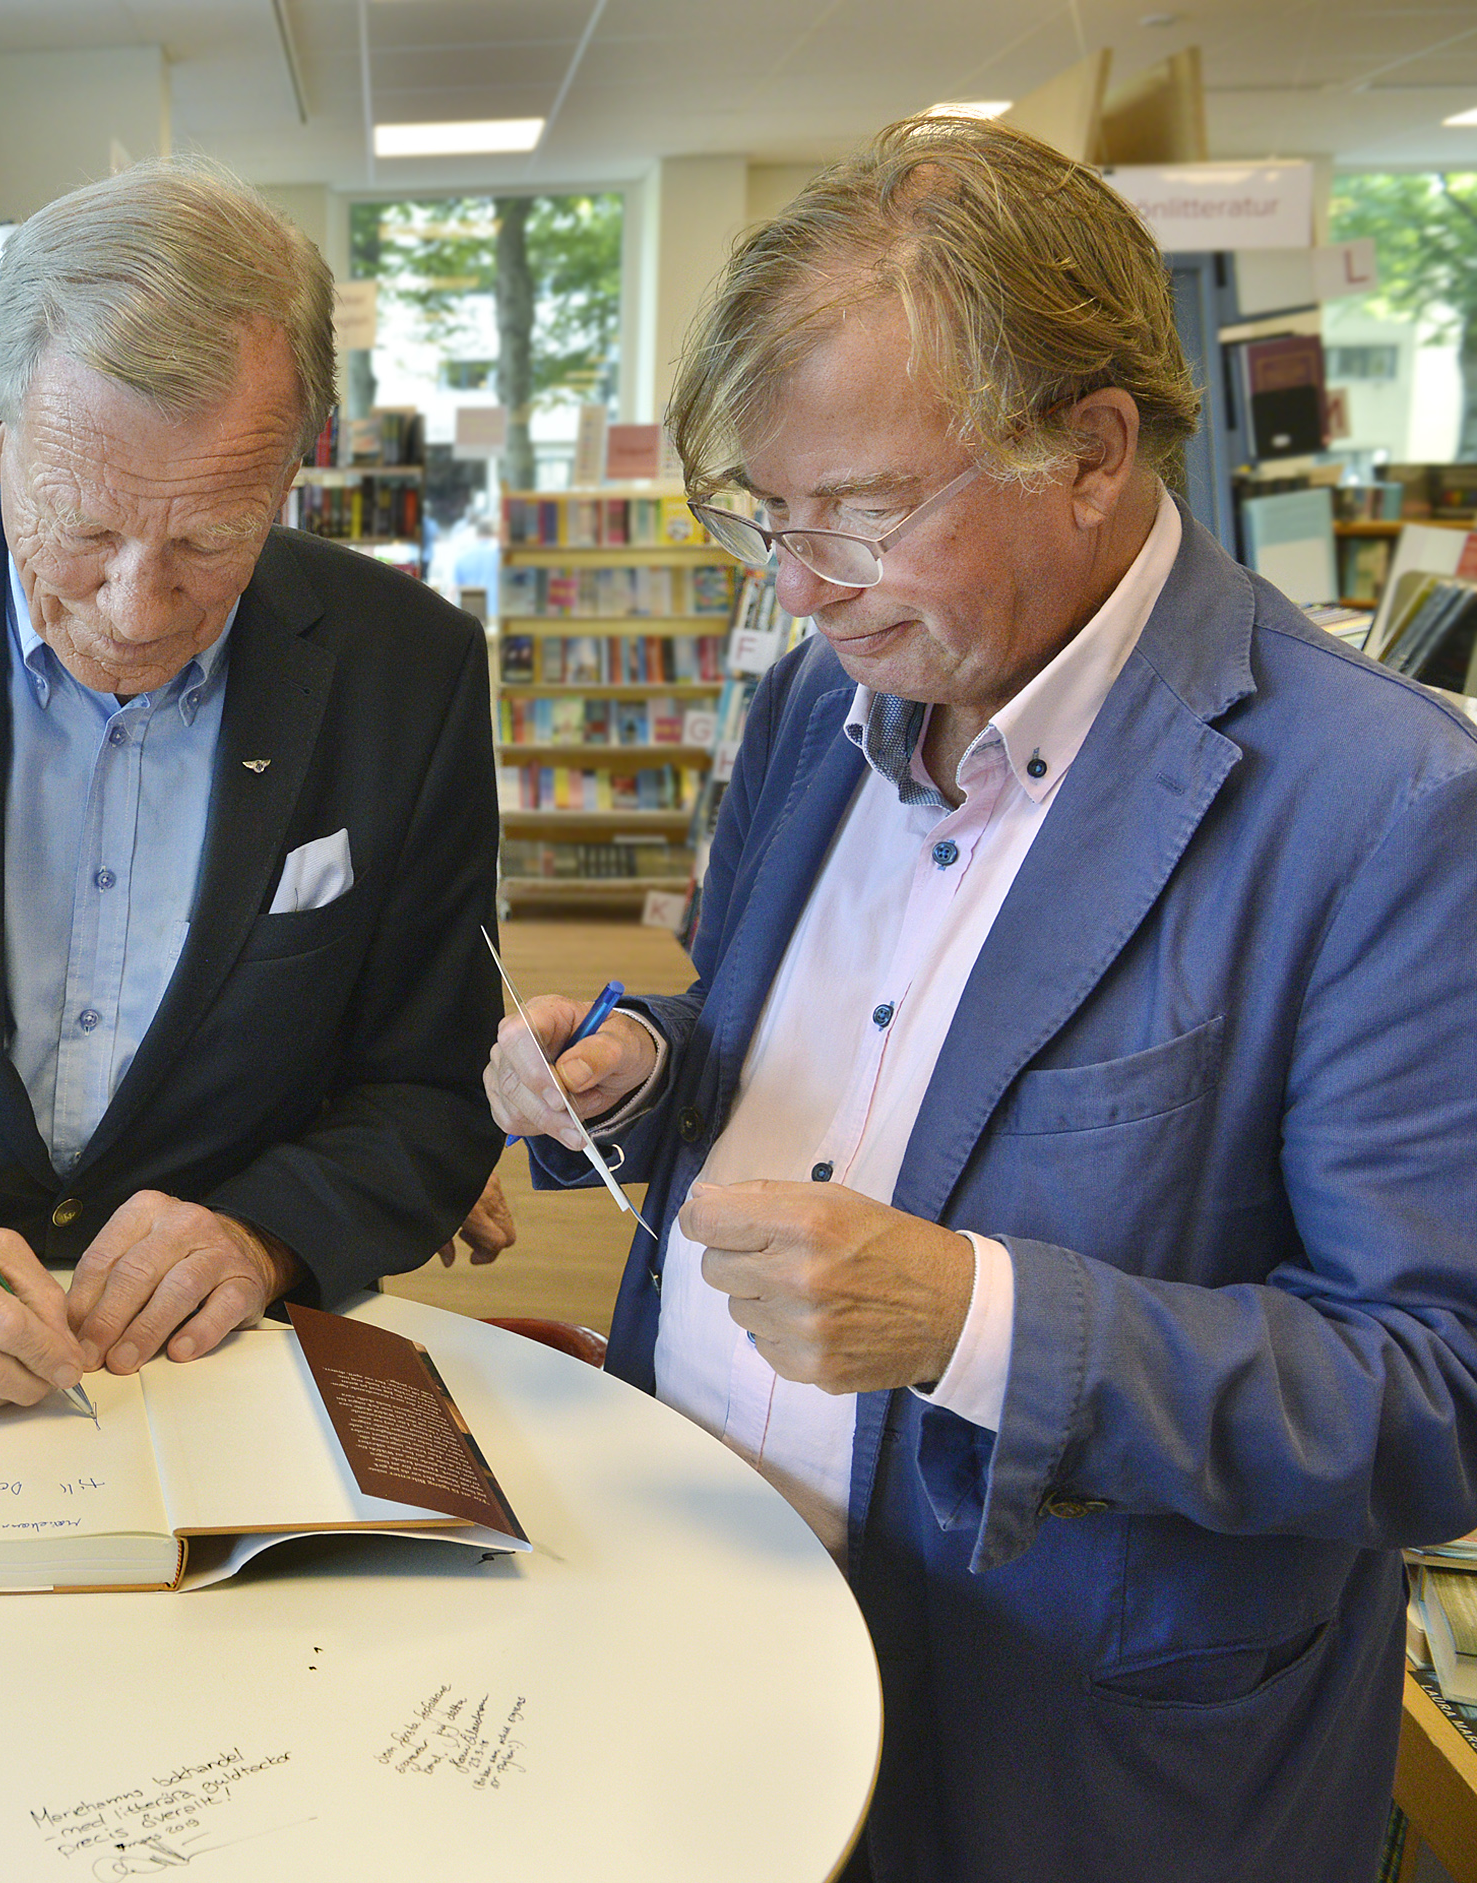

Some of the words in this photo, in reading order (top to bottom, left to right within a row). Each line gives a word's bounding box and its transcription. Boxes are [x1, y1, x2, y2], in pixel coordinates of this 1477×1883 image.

[1138, 196, 1279, 219] önlitteratur
[1343, 249, 1371, 285] L
[735, 636, 758, 661] F
[688, 716, 713, 743] G
[648, 902, 670, 924] K
[1420, 1684, 1458, 1717] LAURA
[152, 1746, 245, 1787] bokhandel
[60, 1814, 107, 1838] med
[164, 1818, 200, 1835] 2019
[57, 1829, 129, 1860] precis
